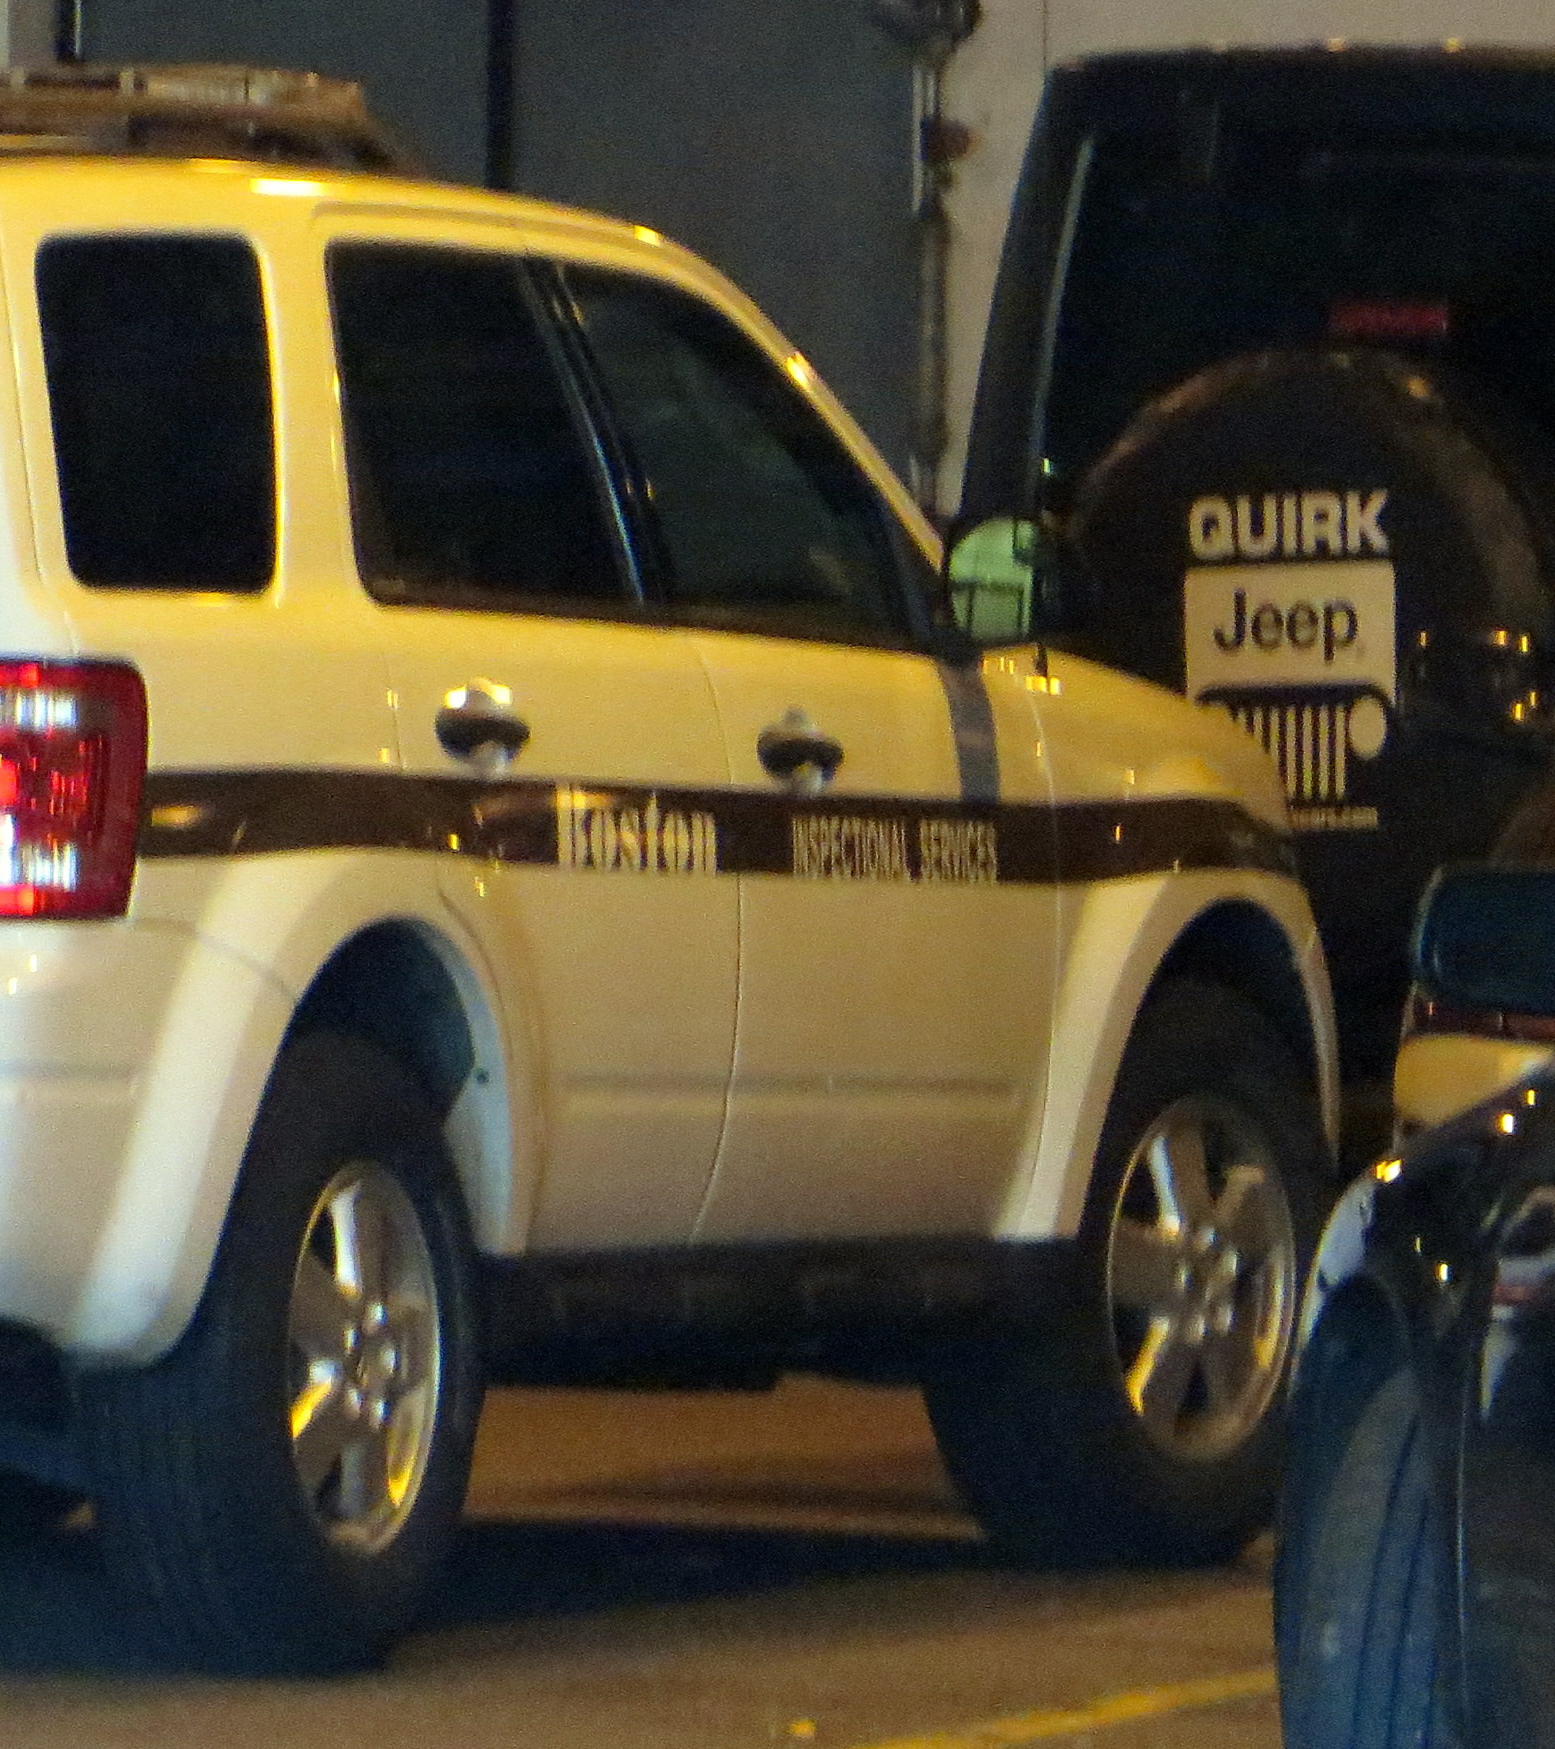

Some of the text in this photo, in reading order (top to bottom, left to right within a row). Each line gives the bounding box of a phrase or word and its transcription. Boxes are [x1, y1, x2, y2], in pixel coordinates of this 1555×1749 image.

[1190, 488, 1389, 560] QUIRK
[1212, 588, 1359, 665] Jeep
[792, 814, 998, 885] INSPECTIONAL SERVICES
